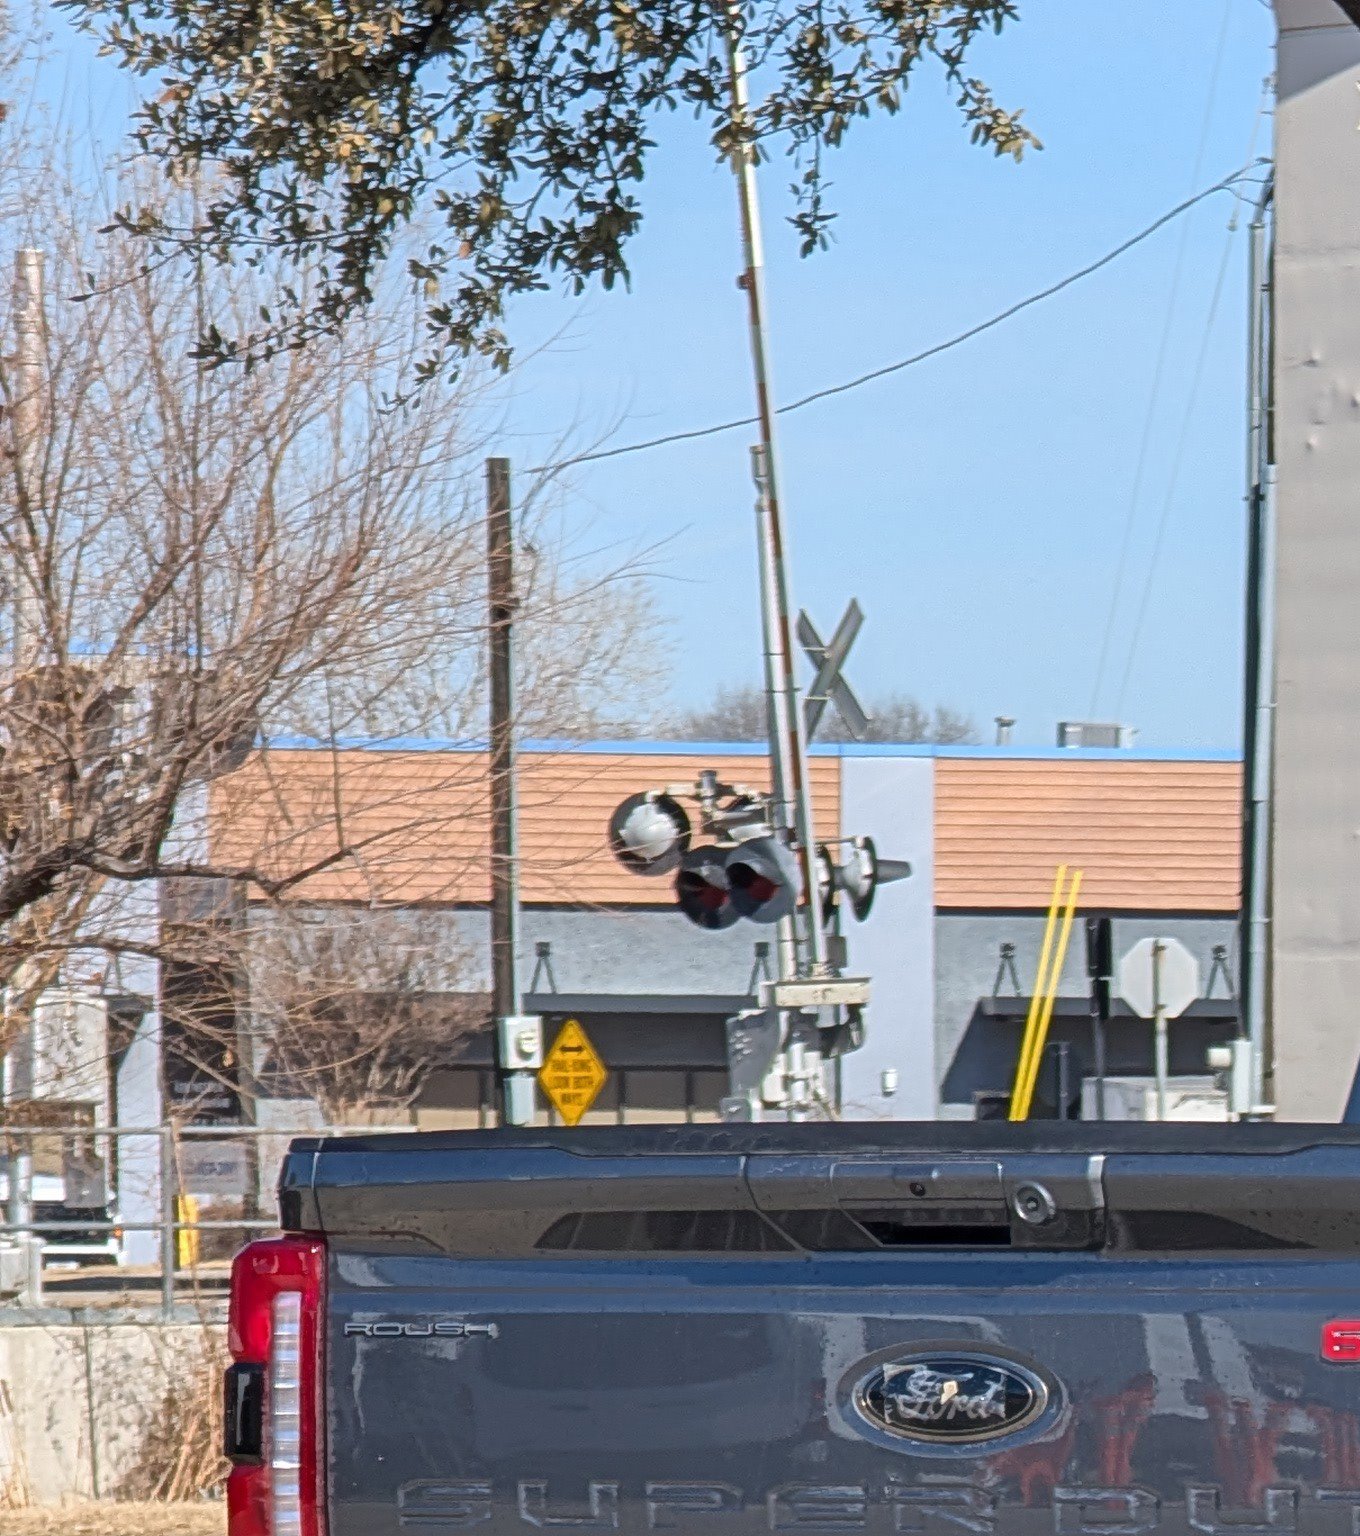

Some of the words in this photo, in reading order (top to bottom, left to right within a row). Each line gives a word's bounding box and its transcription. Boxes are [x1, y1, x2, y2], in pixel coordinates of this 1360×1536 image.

[344, 1322, 500, 1339] ROUSH
[886, 1368, 1005, 1422] Ford
[398, 1478, 997, 1535] SUPER
